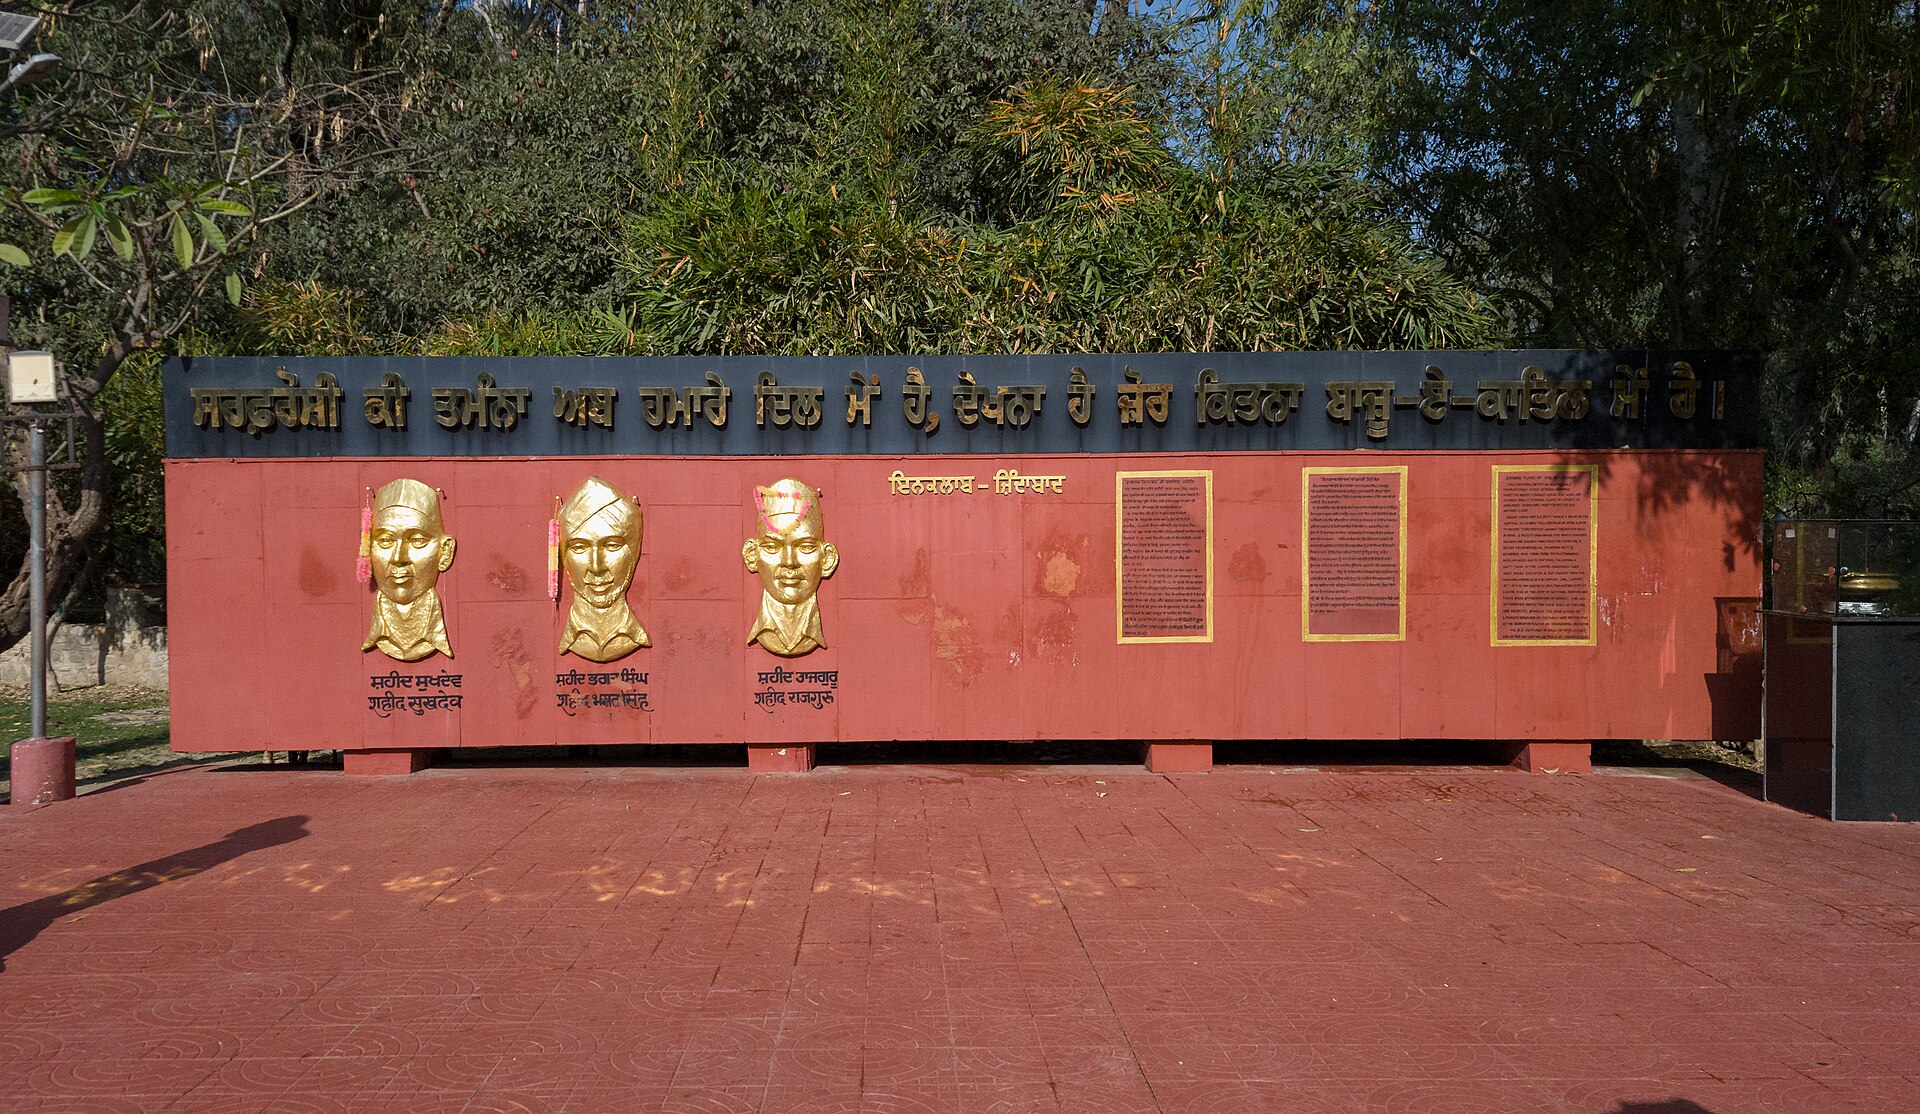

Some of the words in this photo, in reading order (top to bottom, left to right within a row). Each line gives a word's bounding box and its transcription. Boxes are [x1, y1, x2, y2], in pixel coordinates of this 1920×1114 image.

[363, 372, 409, 427] ਕੀ
[431, 372, 530, 427] ਤਮੰਨਾ
[552, 387, 616, 427] ਅਬ
[639, 370, 731, 426] ਹਮਾਰੇ
[753, 370, 824, 426] ਦਿਲ
[845, 370, 881, 425] ਮੇਂ
[953, 370, 1046, 425] ਦੇਖਨਾ
[1067, 366, 1096, 424] ਹੈ
[1194, 367, 1305, 423] ਕਿਤਨਾ
[1609, 364, 1650, 420] ਮੇਂ
[370, 670, 414, 690] ਸ਼ਹੀਦ
[415, 669, 463, 692] ਸੁਖਦੇਵ
[757, 665, 794, 685] ਸ਼ਹੀਦ
[795, 670, 839, 689] ਰਾਜਗੁਰੂ
[367, 690, 407, 718] शहीद
[407, 690, 463, 716] सुखदेव
[754, 686, 787, 713] शहीद
